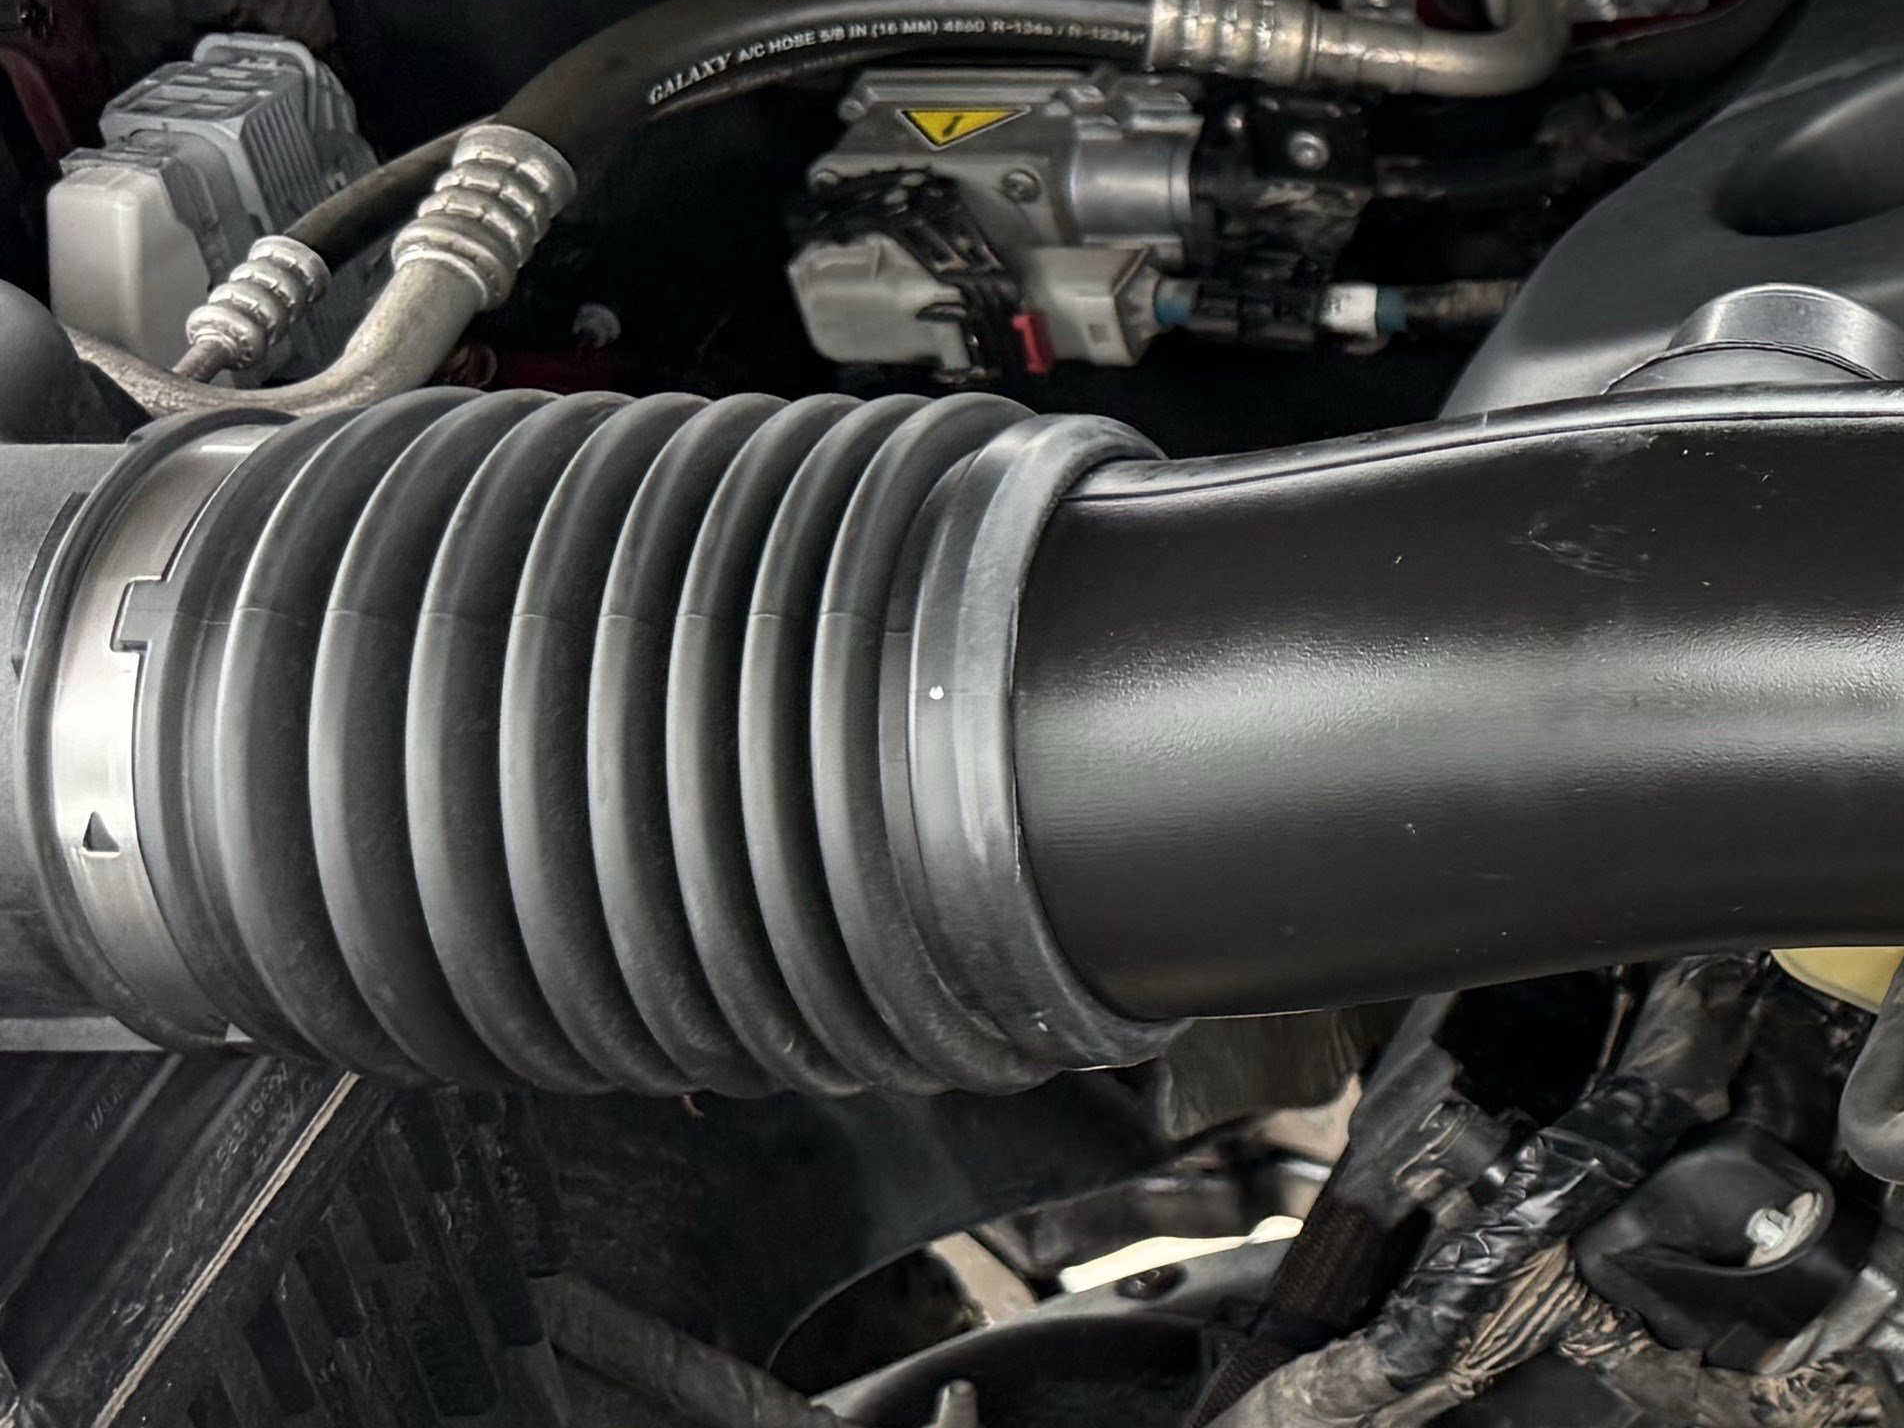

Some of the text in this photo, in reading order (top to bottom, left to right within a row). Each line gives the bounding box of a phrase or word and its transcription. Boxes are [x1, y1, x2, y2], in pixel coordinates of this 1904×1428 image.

[649, 52, 732, 105] GALAXY
[737, 43, 766, 64] A/C
[768, 30, 817, 54] HOSE
[848, 24, 867, 39] IN
[902, 18, 939, 36] MM)
